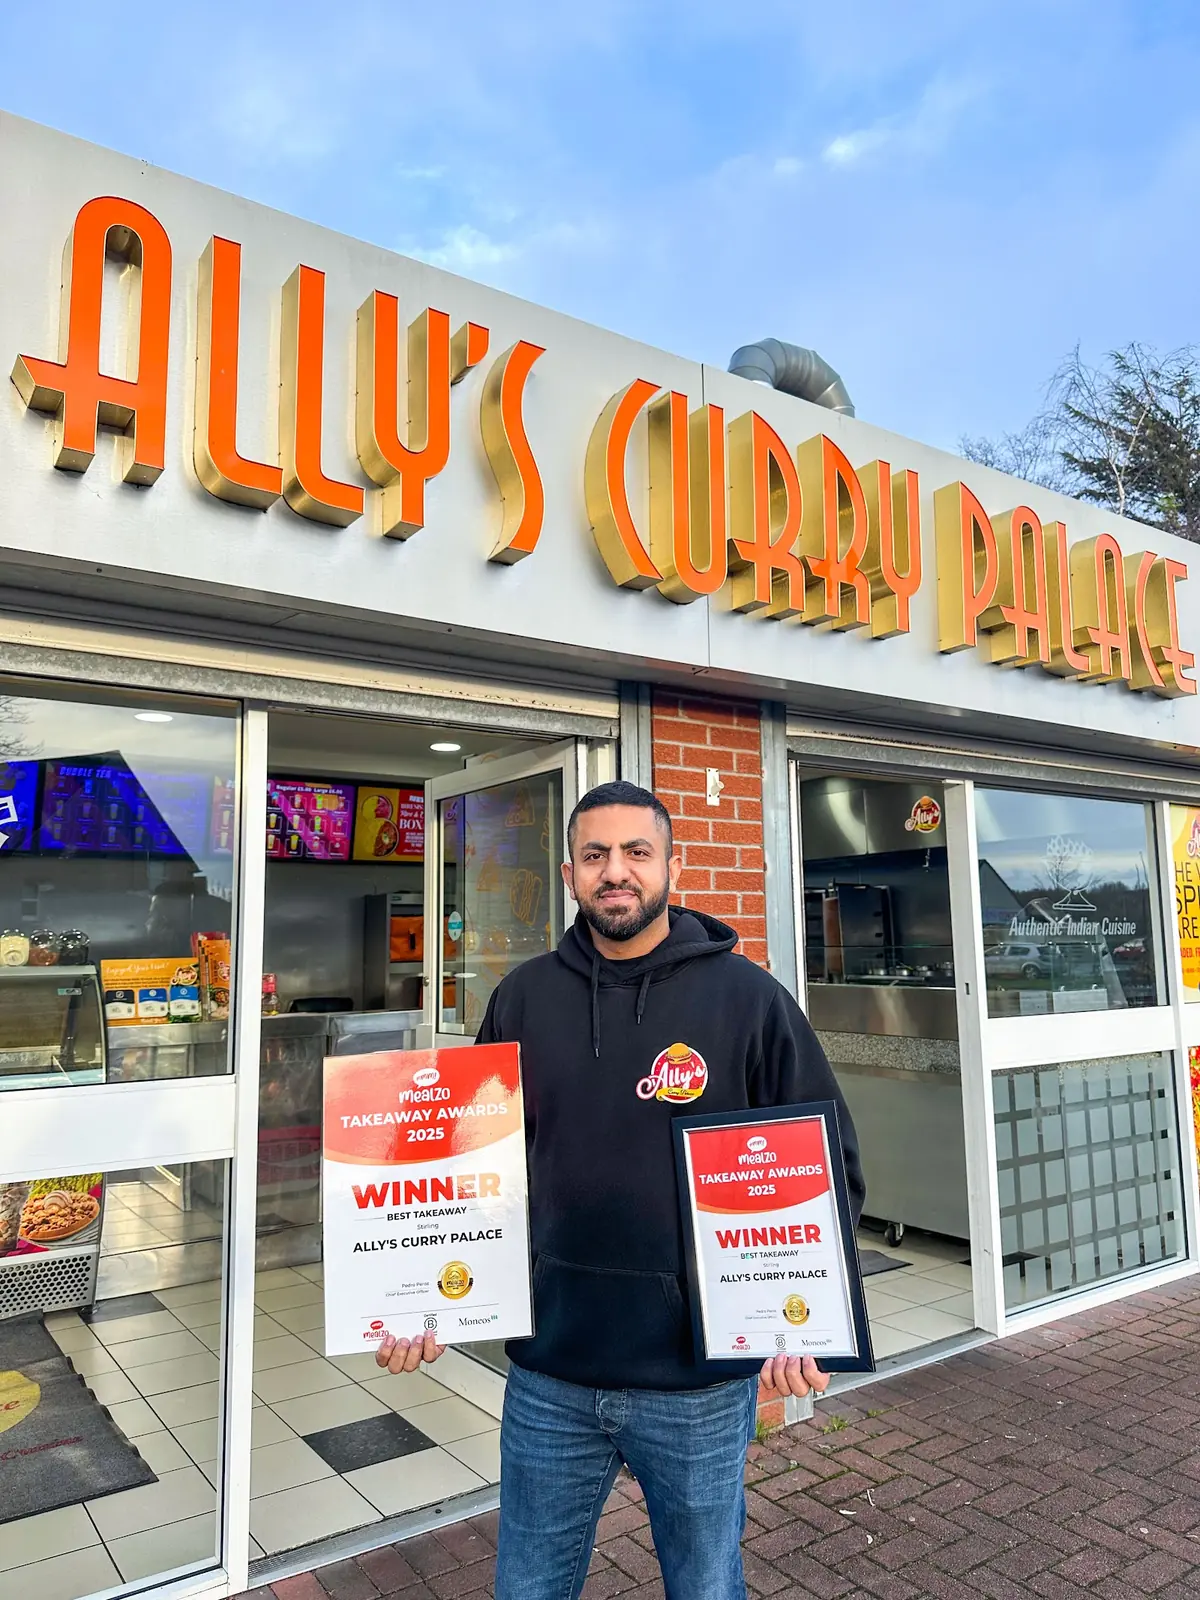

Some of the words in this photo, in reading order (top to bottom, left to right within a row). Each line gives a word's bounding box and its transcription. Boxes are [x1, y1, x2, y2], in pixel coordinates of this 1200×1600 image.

[12, 196, 547, 562] ALLY'S
[585, 378, 920, 640] CURRY
[935, 481, 1197, 699] PALACE
[276, 784, 297, 792] Regular
[1008, 916, 1063, 937] Authentic
[1067, 916, 1099, 936] Indian
[1102, 916, 1137, 936] Cuisine
[636, 1062, 706, 1100] Ally's
[398, 1087, 451, 1104] mealzo
[340, 1109, 433, 1129] TAKEAWAY
[435, 1102, 509, 1121] AWARDS
[406, 1127, 446, 1143] 2025
[737, 1151, 777, 1165] mealzo
[698, 1167, 765, 1186] TAKEAWAY
[767, 1163, 824, 1180] AWARDS
[351, 1173, 502, 1210] WINNER
[747, 1184, 776, 1197] 2025
[387, 1211, 412, 1222] BEST
[413, 1206, 468, 1219] TAKEAWAY
[416, 1223, 440, 1231] Stirling
[353, 1239, 399, 1254] ALLY'S
[401, 1234, 447, 1249] CURRY
[450, 1228, 504, 1243] PALACE
[714, 1223, 823, 1250] WINNER
[740, 1250, 758, 1260] BEST
[759, 1249, 800, 1259] TAKEAWAY
[719, 1272, 751, 1284] ALLY'S
[752, 1271, 787, 1282] CURRY
[788, 1269, 828, 1280] PALACE
